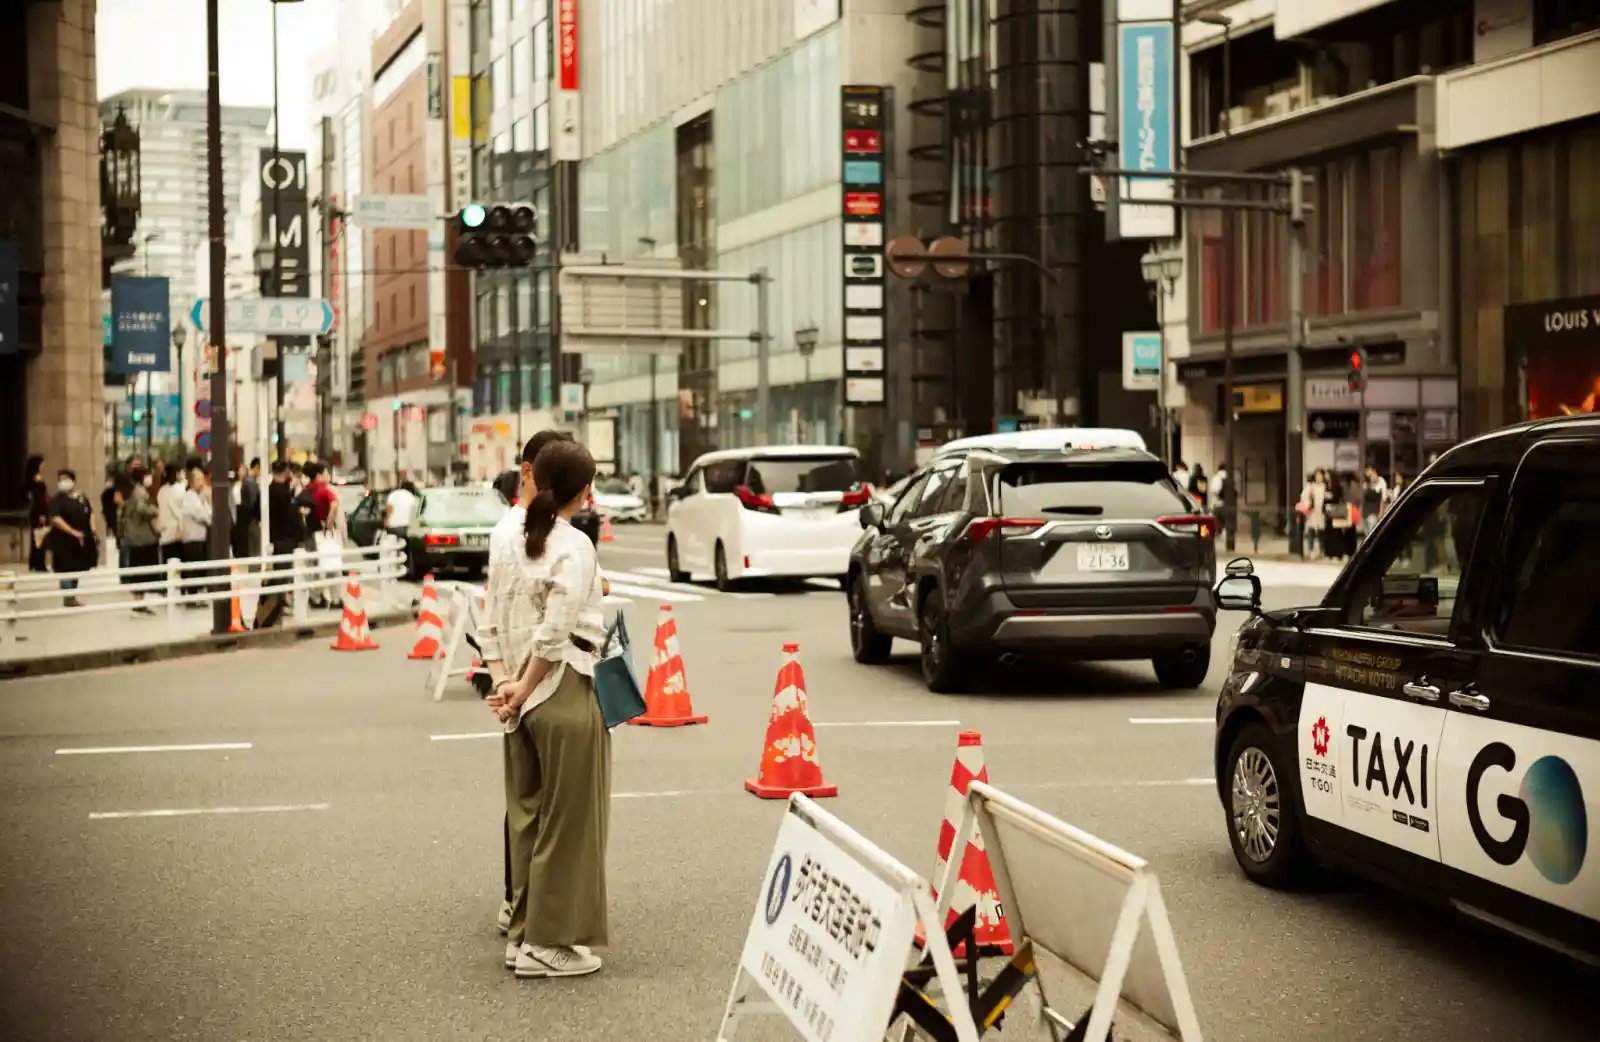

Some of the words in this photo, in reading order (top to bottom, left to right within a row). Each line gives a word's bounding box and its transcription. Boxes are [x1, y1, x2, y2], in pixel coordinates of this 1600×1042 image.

[1544, 309, 1589, 332] LOUIS
[1306, 758, 1336, 778] 日本交通
[1347, 724, 1429, 809] TAXI
